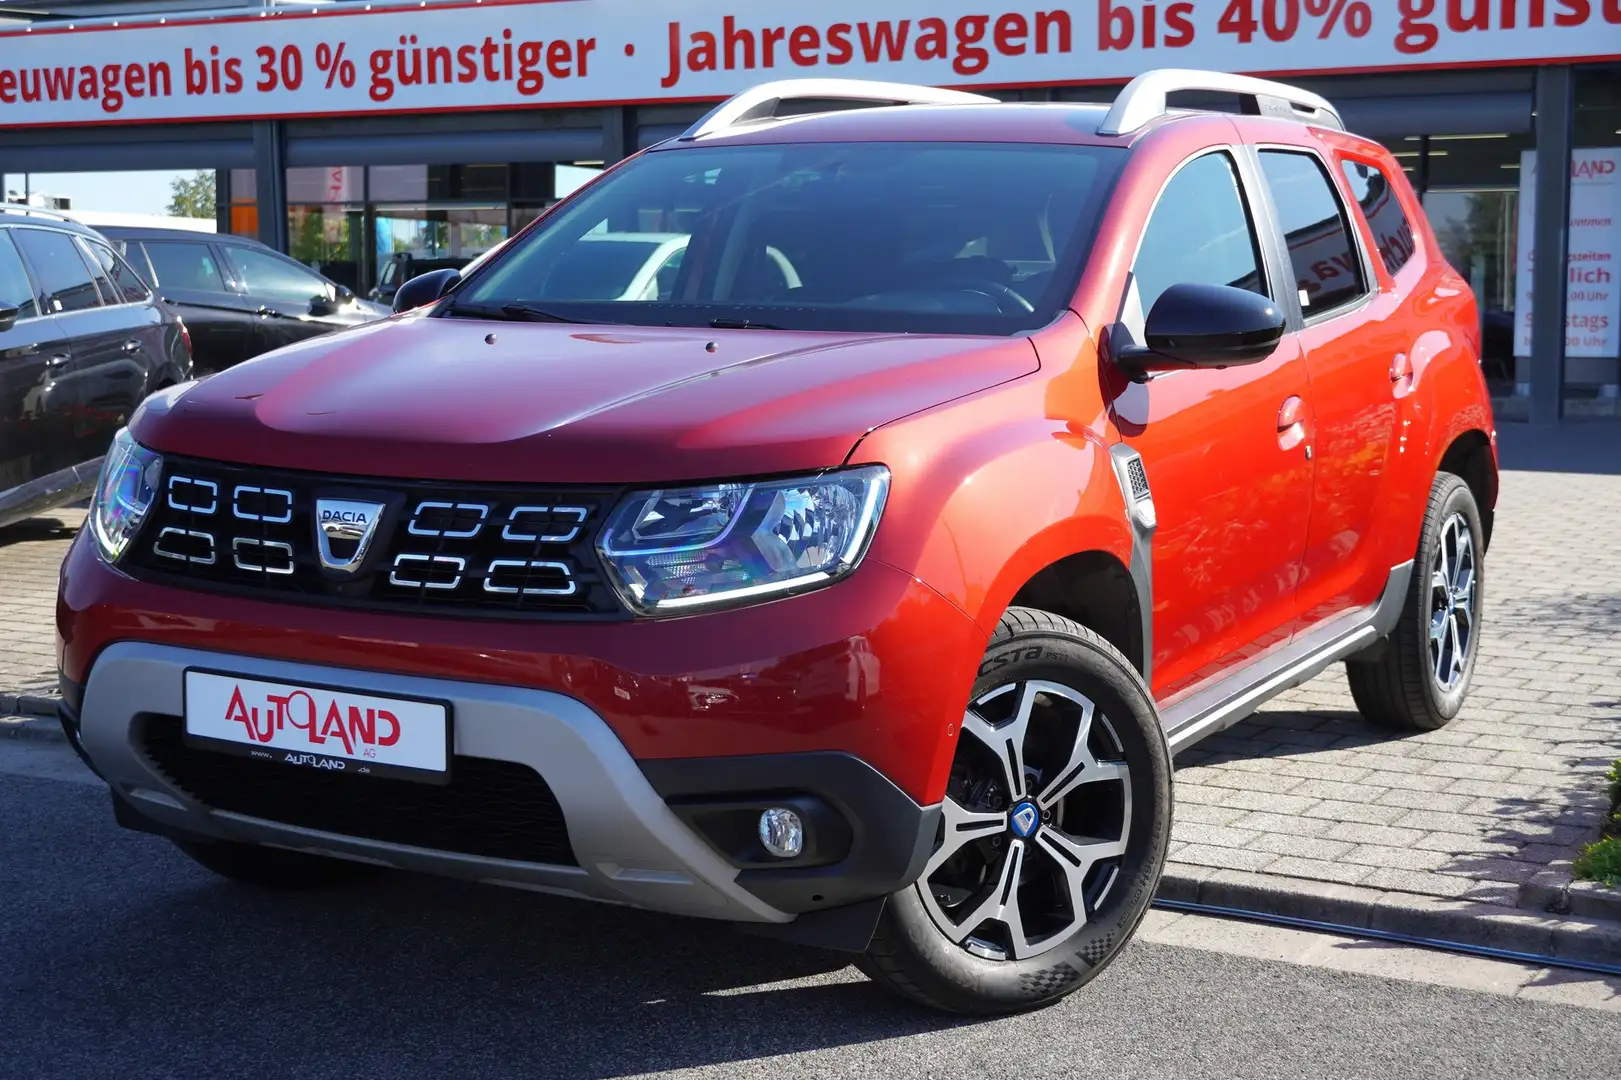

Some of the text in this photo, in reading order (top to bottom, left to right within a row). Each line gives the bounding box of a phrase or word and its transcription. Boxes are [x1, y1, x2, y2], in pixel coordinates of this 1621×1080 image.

[185, 46, 243, 94] bis
[256, 45, 303, 92] 30
[315, 42, 356, 89] %
[369, 29, 596, 102] günstiger
[661, 11, 1071, 88] Jahreswagen
[1098, 0, 1195, 51] bis
[1217, 0, 1371, 43] 40%
[322, 510, 367, 524] DACIA
[225, 684, 401, 755] AUTOLAND
[250, 750, 371, 774] www. AUTOLAND .de
[363, 748, 377, 759] AG
